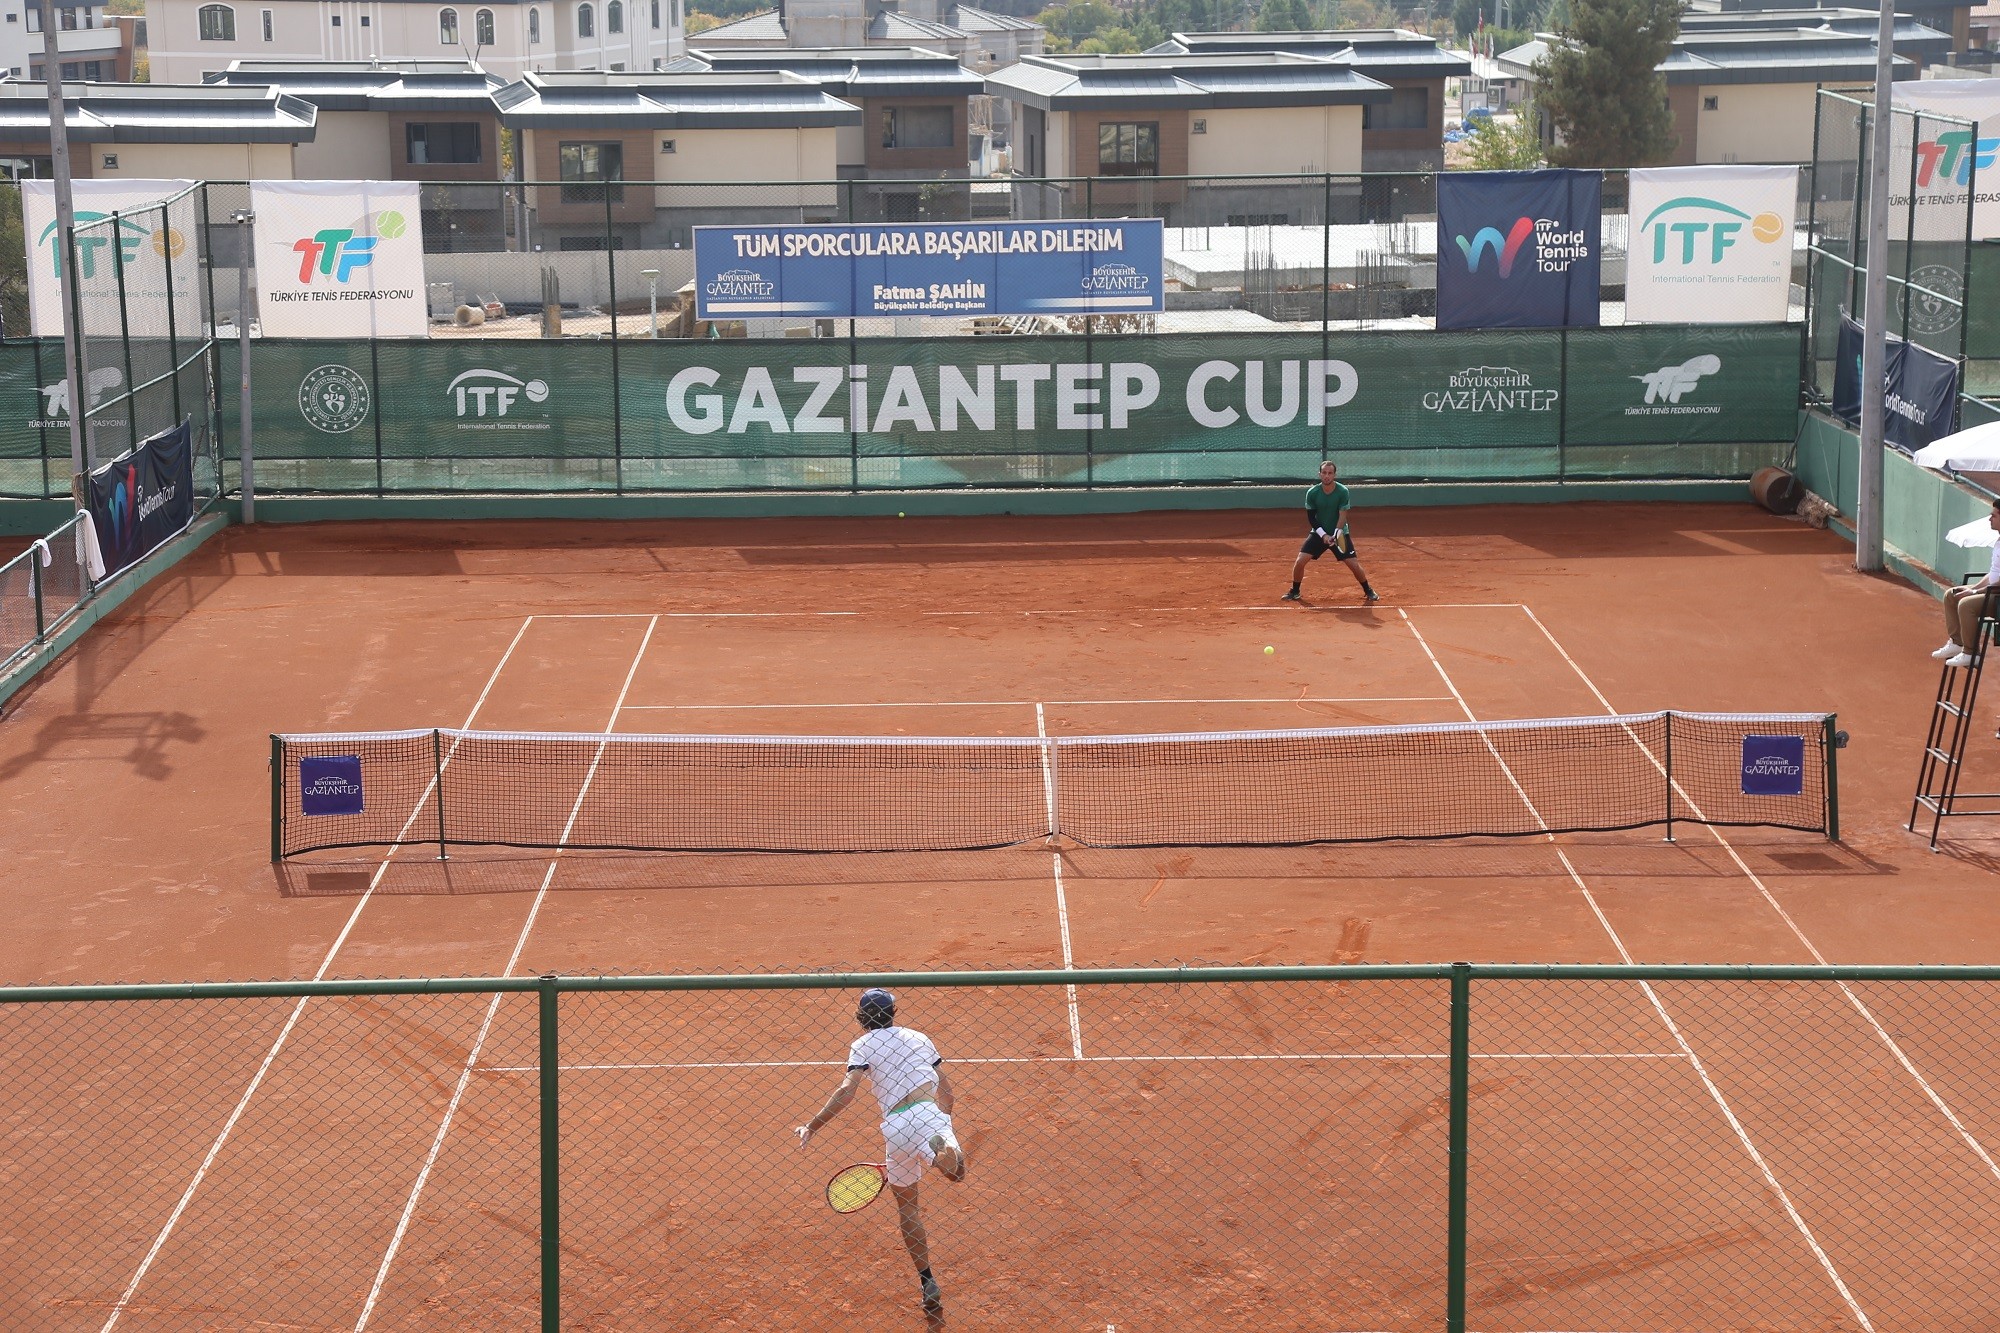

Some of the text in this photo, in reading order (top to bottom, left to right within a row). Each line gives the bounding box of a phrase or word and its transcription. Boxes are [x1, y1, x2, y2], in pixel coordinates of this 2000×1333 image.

[1889, 193, 2000, 206] ÜRKYE TENİS FEERAS
[1536, 223, 1552, 231] ITF
[783, 232, 921, 257] SPORCULARA
[924, 230, 1039, 260] BAŞARILAR
[1041, 228, 1123, 253] DİLERİM
[1536, 230, 1584, 245] World
[1653, 222, 1743, 265] ITF
[292, 228, 379, 284] TTF
[1536, 244, 1588, 259] Tennis
[1536, 259, 1571, 272] Tour
[1652, 274, 1781, 283] International Tennis Federation
[270, 289, 414, 302] TÜRKİYE TENİS FEDERASYONU
[873, 279, 986, 303] Fatma ŞAHİN
[874, 301, 986, 311] Büyükşehir Belediye Başkanı
[1449, 373, 1532, 388] BÜYÜKŞEHİR
[456, 387, 519, 416] ITF
[1186, 360, 1359, 428] CUP
[1423, 388, 1559, 412] GAZİANTEP
[1624, 406, 1721, 415] TÜRKİYE TENİS FEDERASYONU
